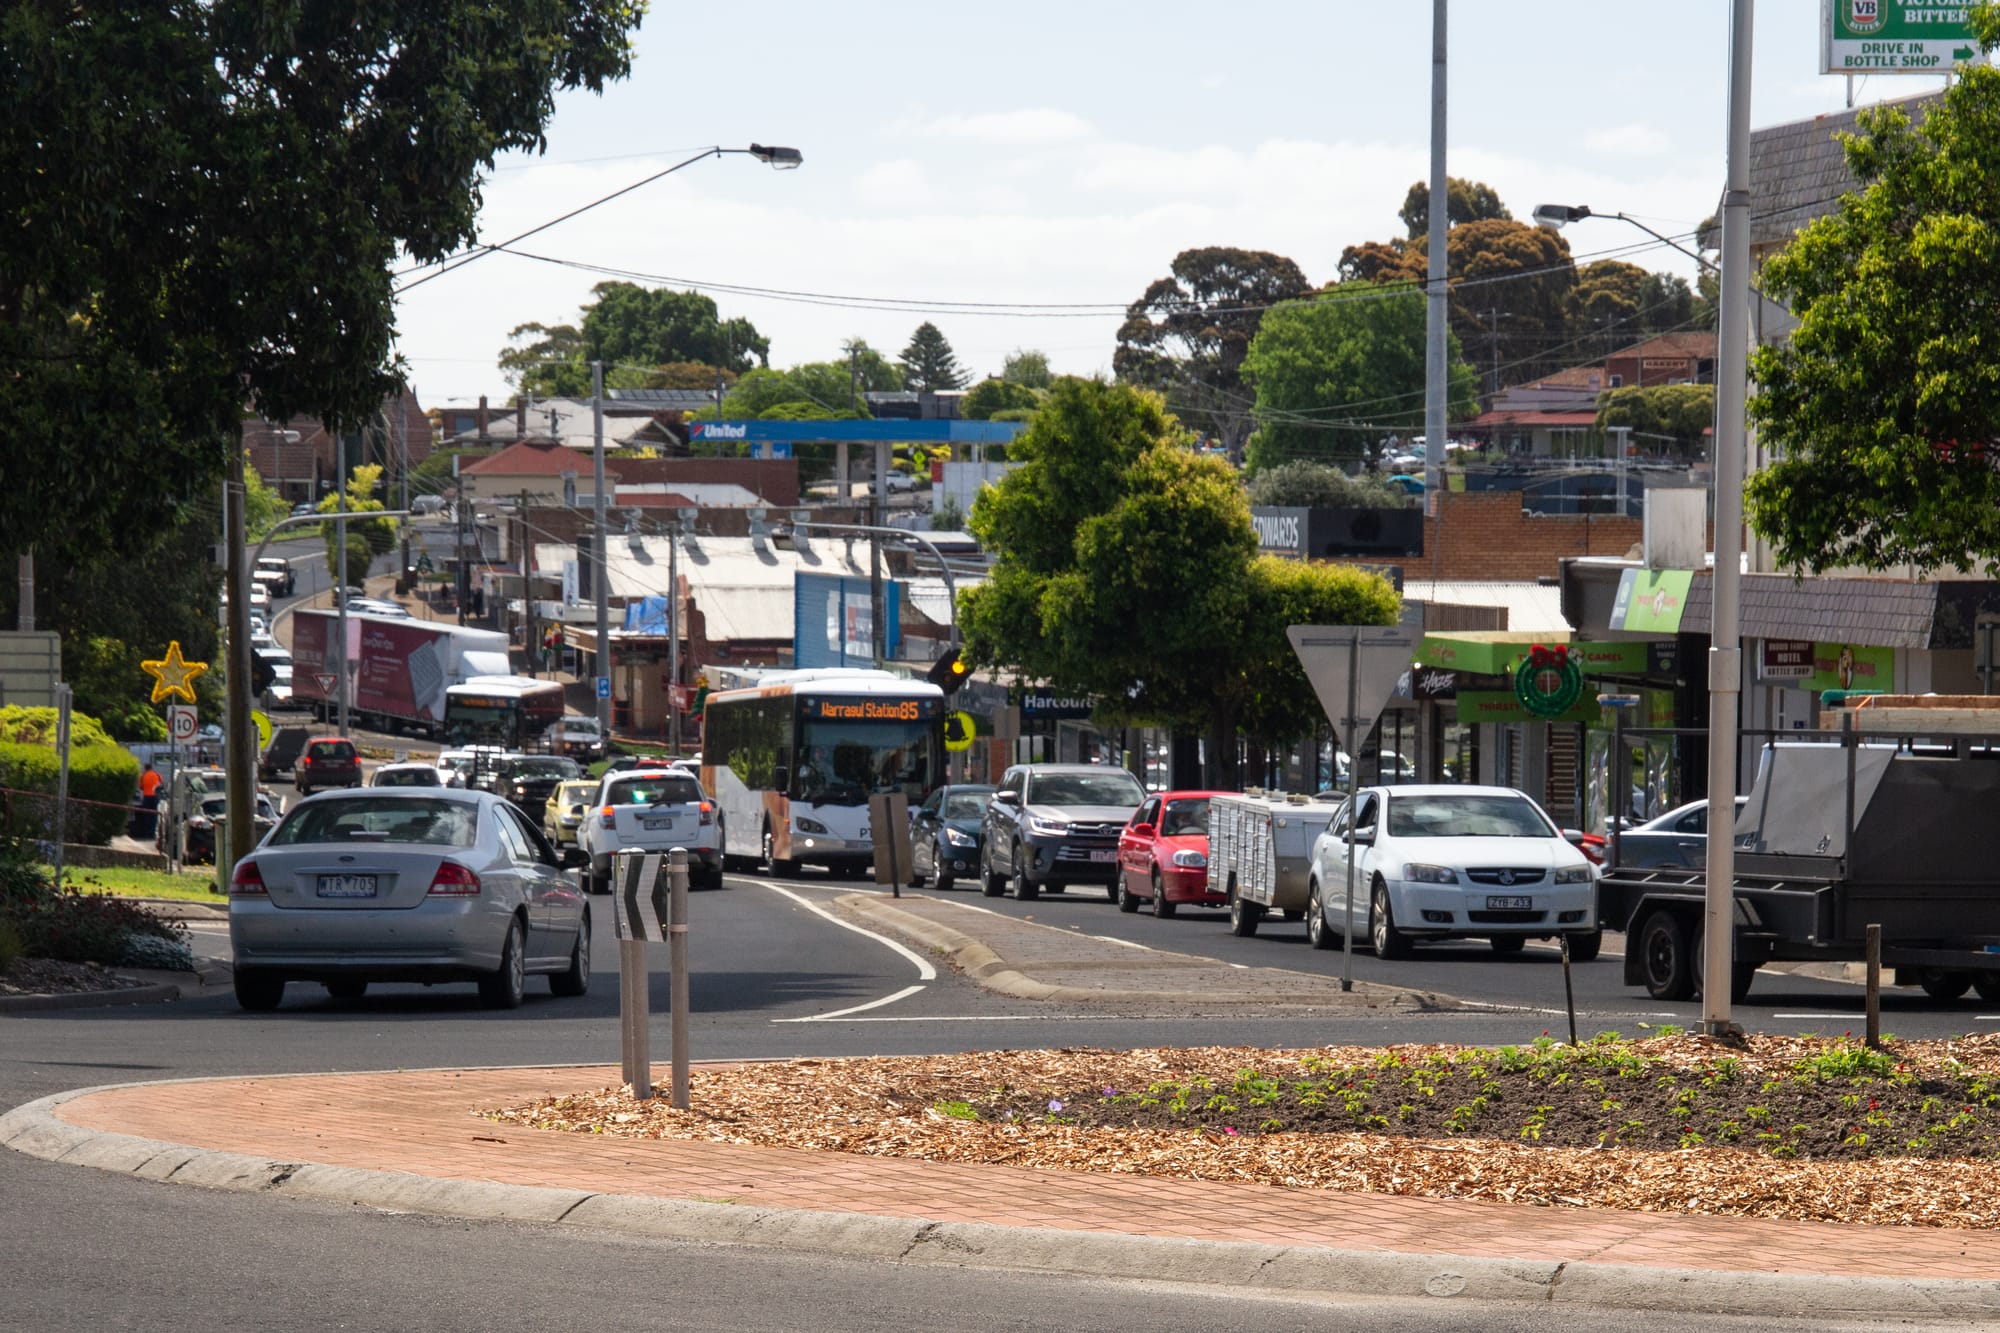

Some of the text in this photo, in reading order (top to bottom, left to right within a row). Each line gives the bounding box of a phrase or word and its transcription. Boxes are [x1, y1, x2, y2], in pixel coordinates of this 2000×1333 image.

[1854, 2, 1877, 14] VB
[1861, 42, 1924, 54] DRIVE IN
[1844, 55, 1941, 67] BOTTLE SHOP
[704, 424, 746, 438] United
[1777, 652, 1801, 663] HOTEL
[865, 703, 900, 718] Station
[900, 702, 919, 720] 85
[320, 878, 375, 890] WTR 705
